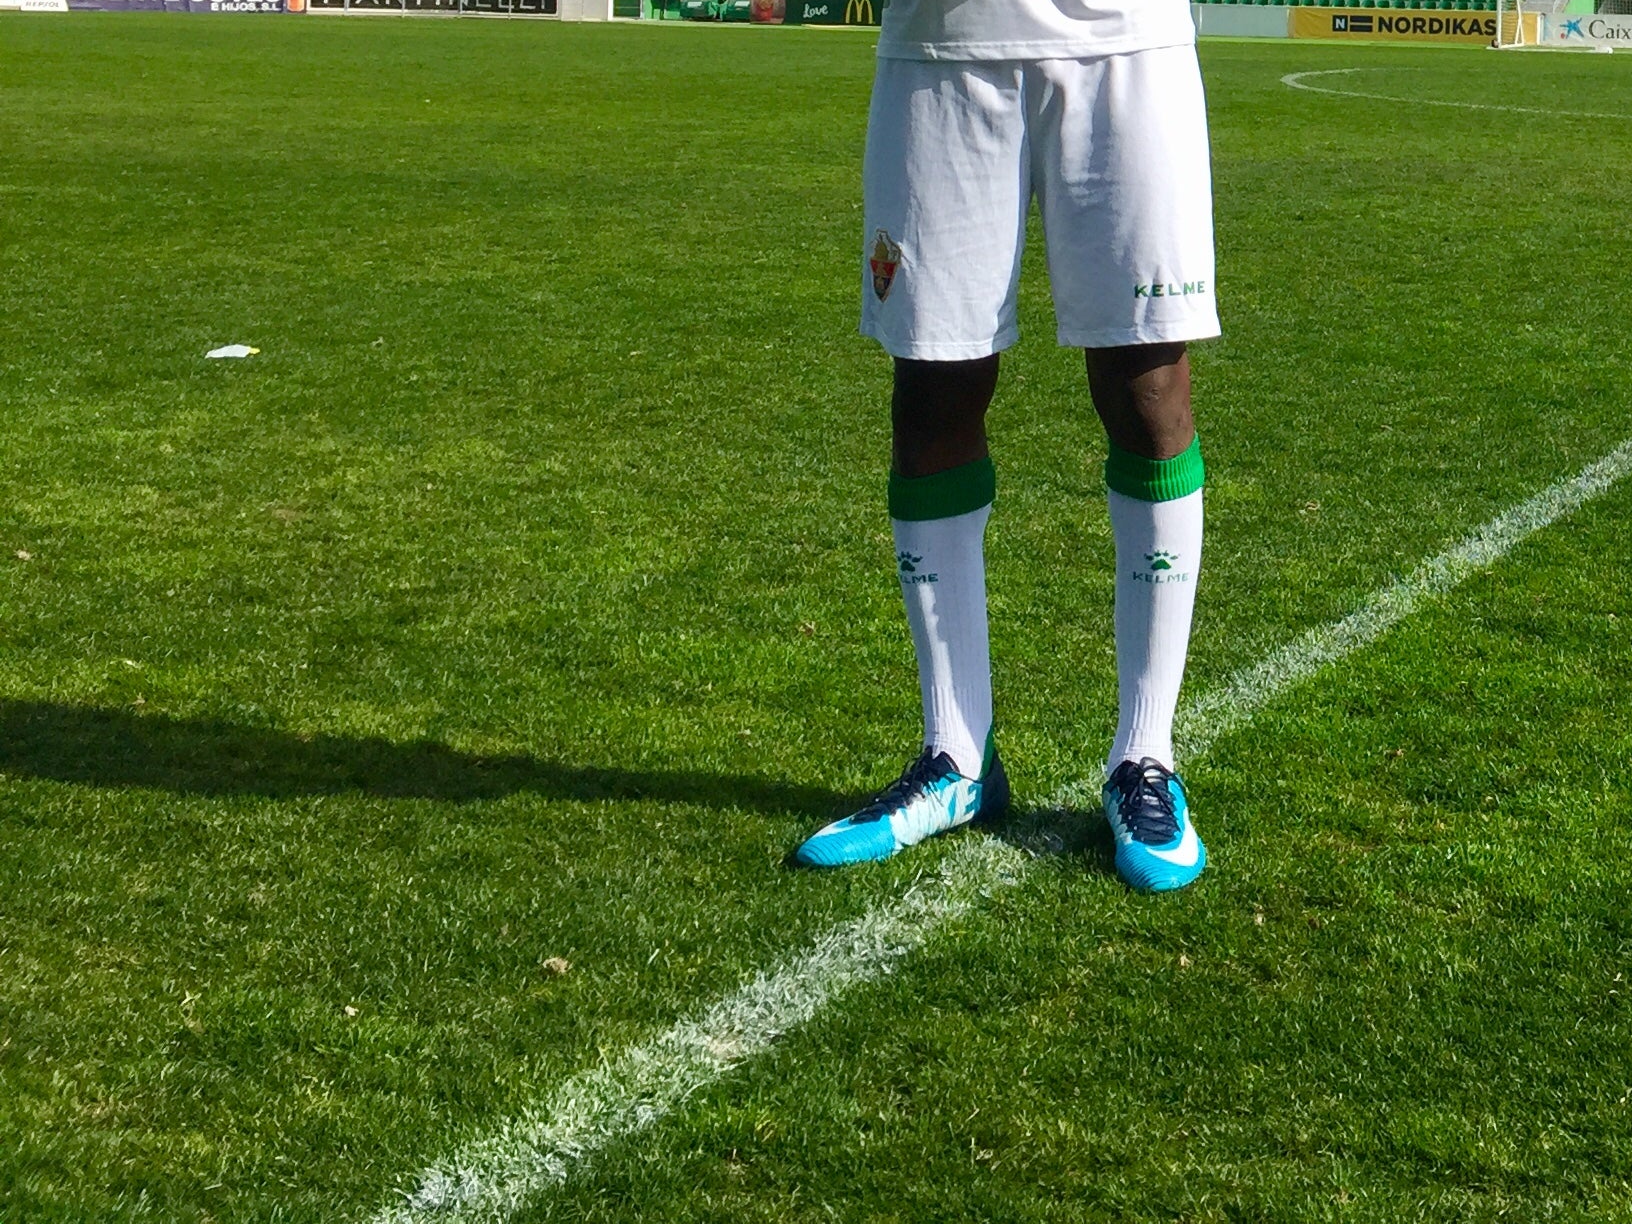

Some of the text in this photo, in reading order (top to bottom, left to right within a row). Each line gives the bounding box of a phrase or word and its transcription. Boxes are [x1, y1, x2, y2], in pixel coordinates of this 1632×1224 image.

[1377, 15, 1497, 36] NORDIKAS
[1134, 280, 1206, 299] KELME
[899, 573, 939, 584] LME
[1132, 571, 1190, 584] KELME
